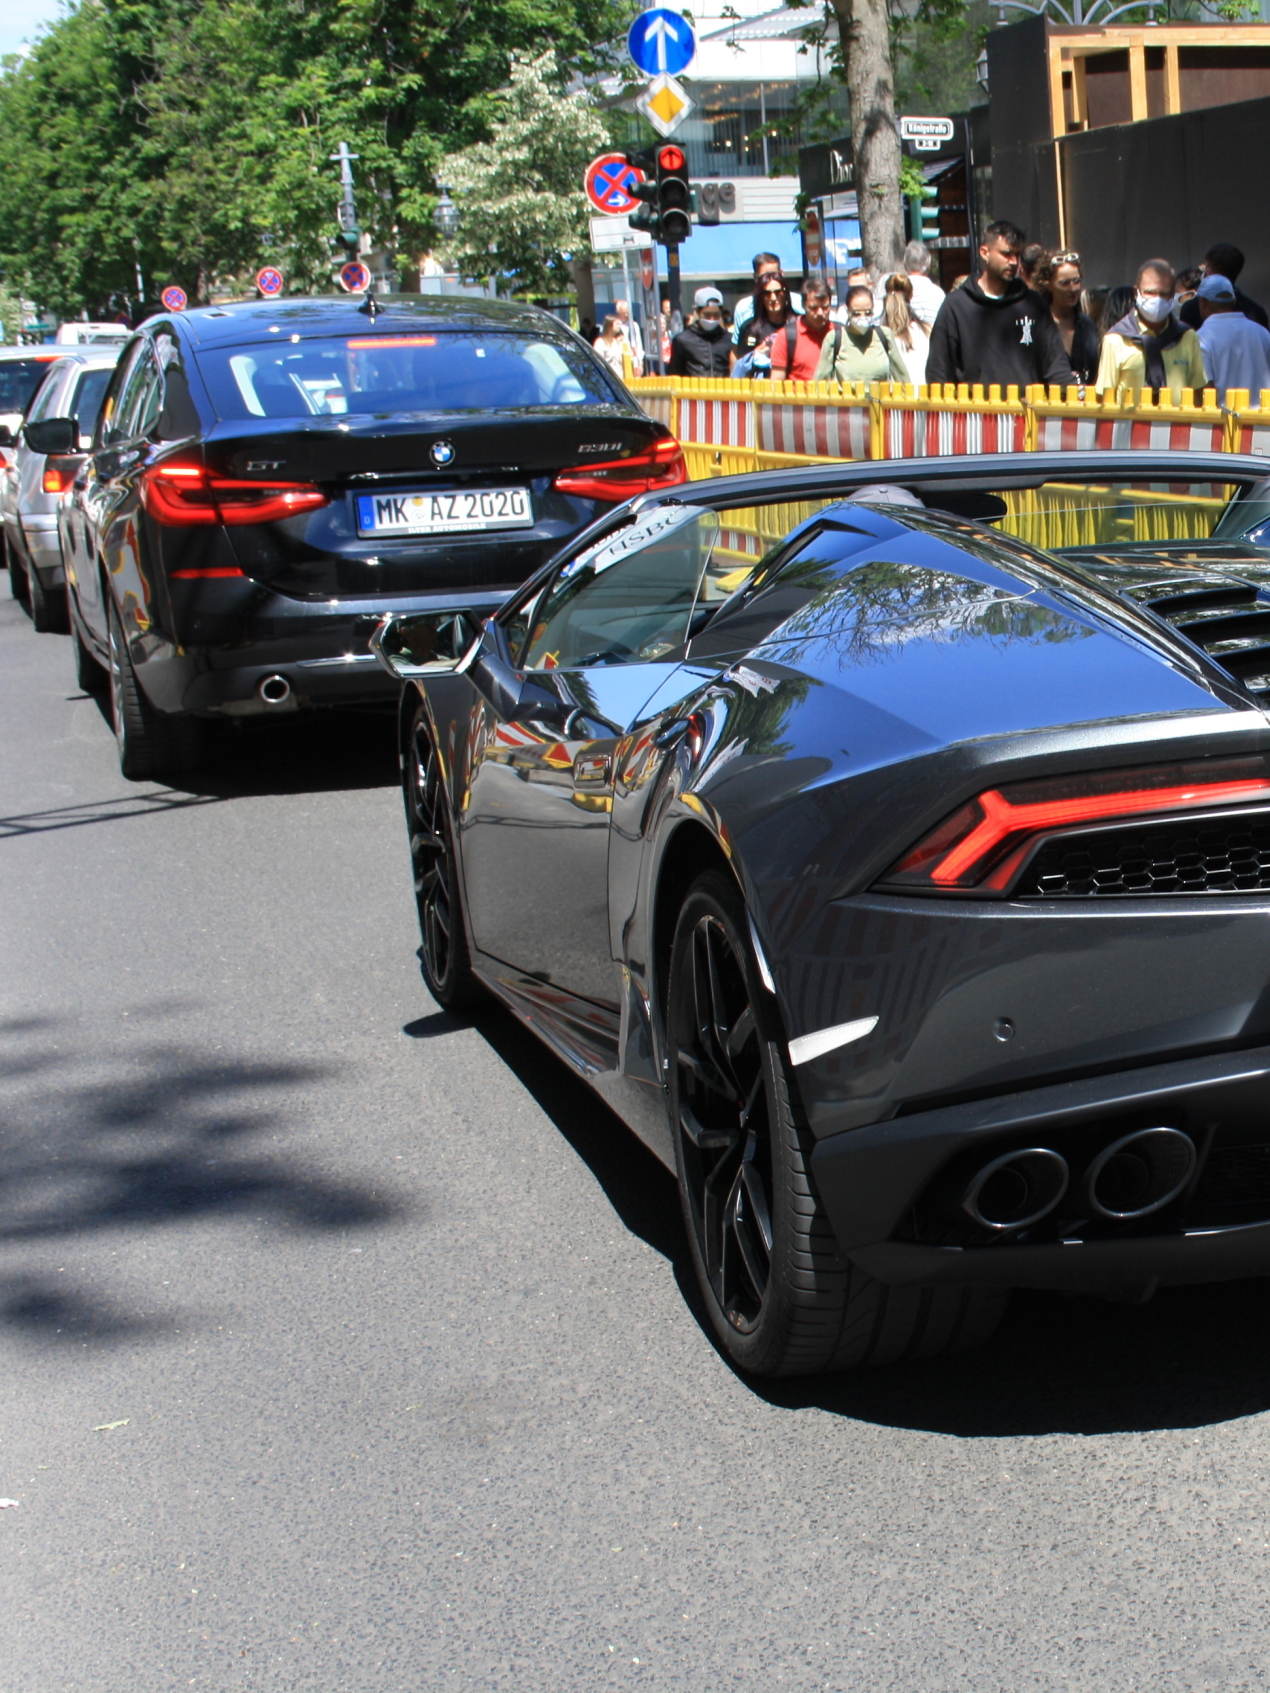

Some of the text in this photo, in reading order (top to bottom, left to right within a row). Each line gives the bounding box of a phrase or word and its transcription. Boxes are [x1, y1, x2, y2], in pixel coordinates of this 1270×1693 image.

[830, 150, 853, 184] Dior
[377, 491, 525, 524] MK AZ 2020
